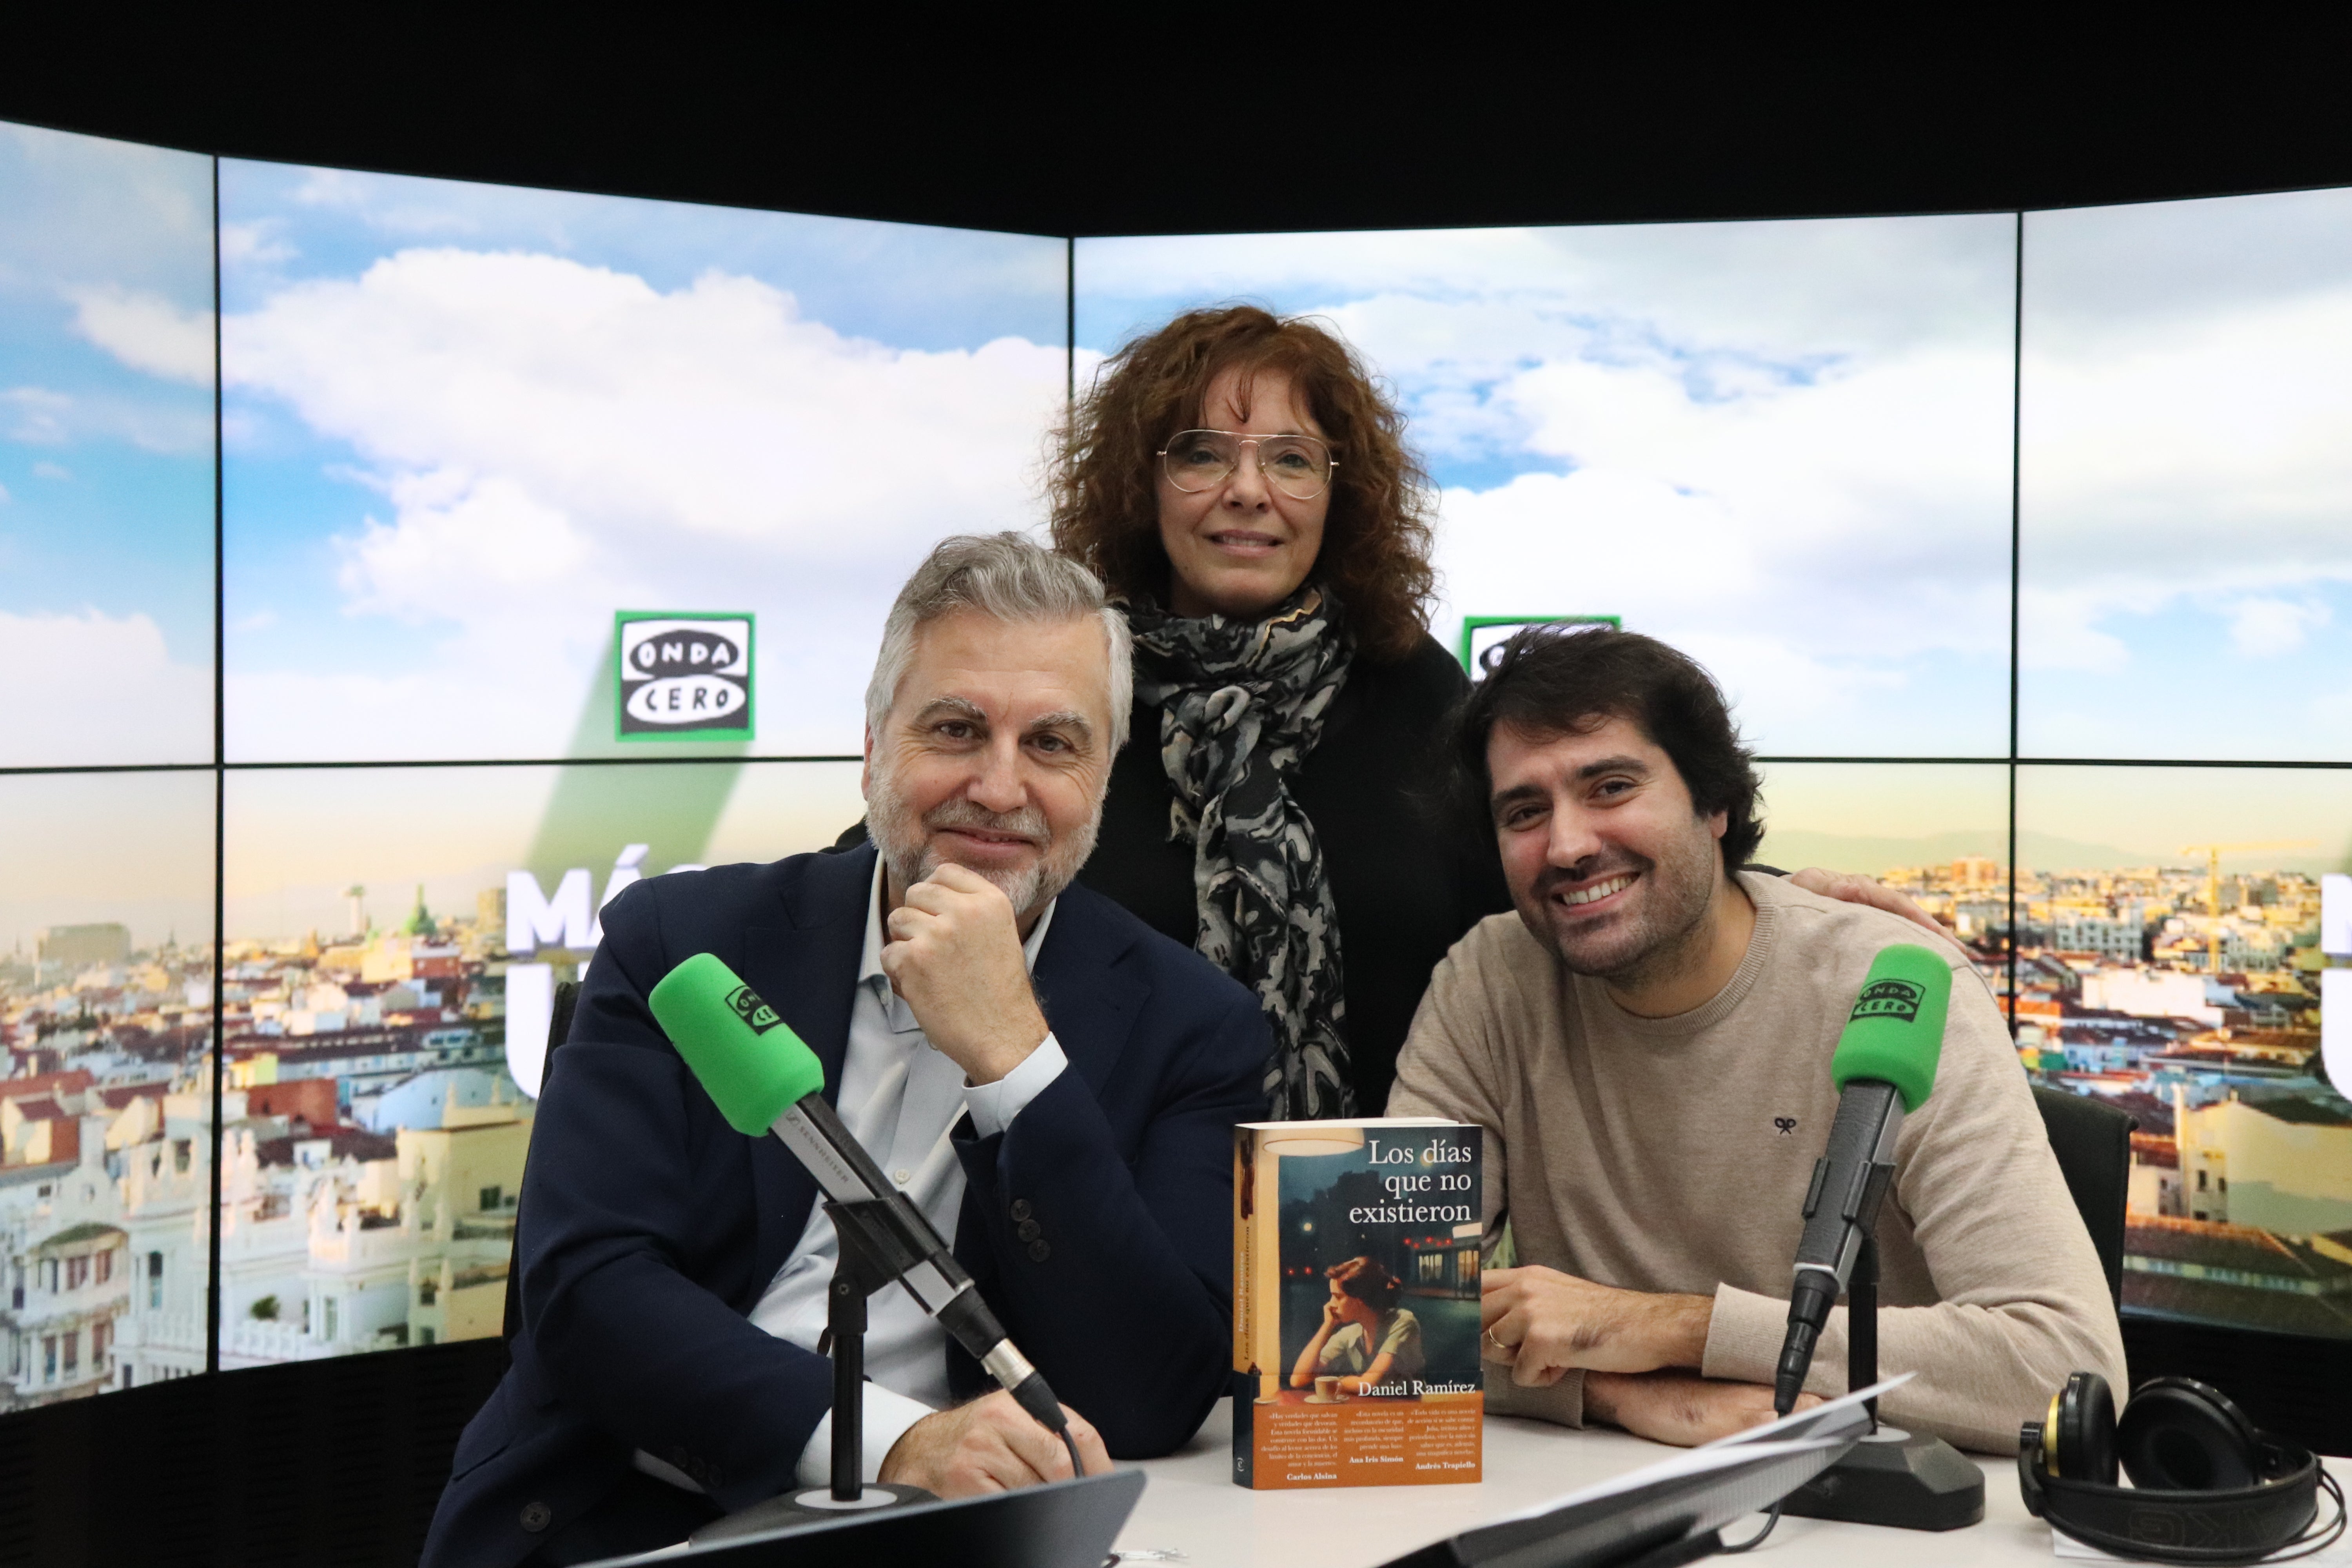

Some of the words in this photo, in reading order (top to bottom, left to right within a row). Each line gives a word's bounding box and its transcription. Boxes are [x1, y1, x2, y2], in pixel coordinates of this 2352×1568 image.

[637, 643, 732, 667] ONDA
[645, 689, 728, 710] CERO
[1864, 987, 1911, 996] ONDA
[1861, 1001, 1906, 1011] CERO
[1369, 1140, 1413, 1164] Los
[1423, 1140, 1472, 1163] días
[1385, 1175, 1431, 1200] que
[1440, 1175, 1471, 1191] no
[1349, 1198, 1471, 1223] existieron
[1244, 1280, 1249, 1293] no
[1359, 1381, 1408, 1396] Daniel
[1412, 1380, 1475, 1394] Ramírez
[1443, 1461, 1475, 1470] Trapiello
